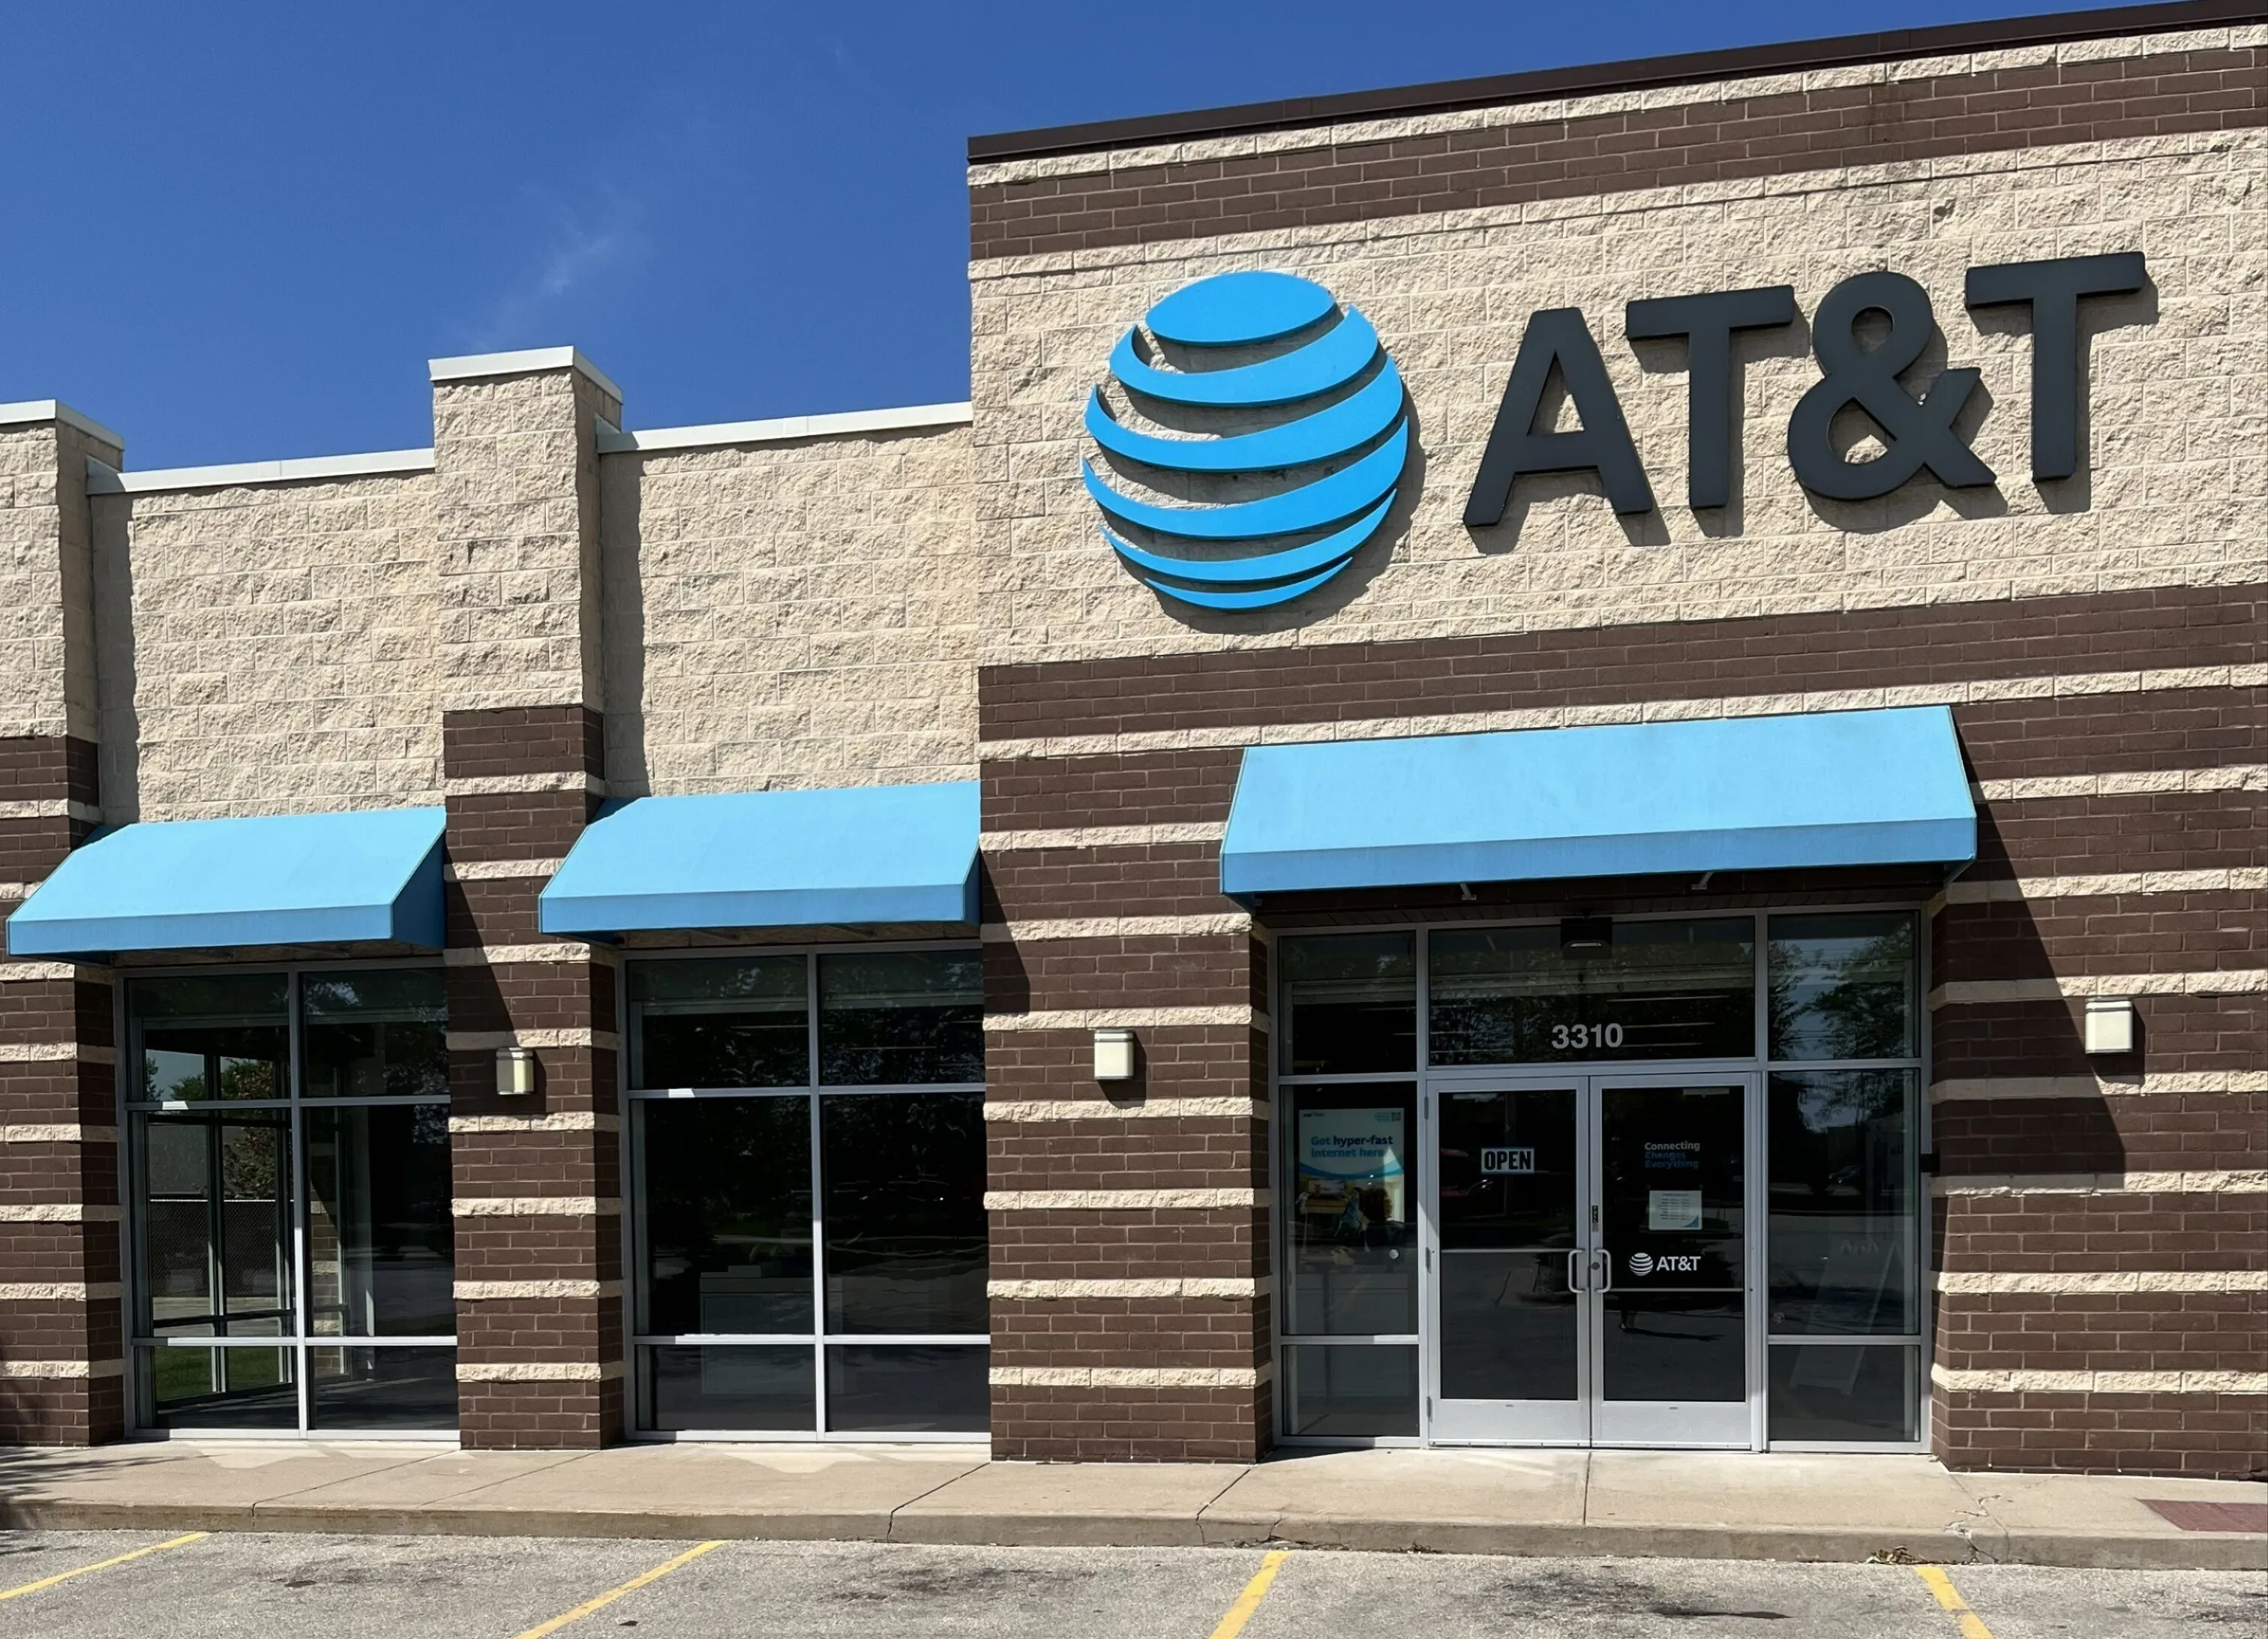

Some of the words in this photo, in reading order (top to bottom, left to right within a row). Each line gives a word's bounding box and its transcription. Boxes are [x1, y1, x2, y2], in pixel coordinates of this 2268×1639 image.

[1463, 251, 2145, 527] AT&T
[1551, 1023, 1623, 1049] 3310
[1311, 1136, 1330, 1145] Get
[1334, 1135, 1394, 1148] hyper-fast
[1644, 1140, 1700, 1151] Connecting
[1484, 1151, 1532, 1170] OPEN
[1645, 1151, 1686, 1160] Changes
[1645, 1160, 1699, 1169] Everything
[1656, 1256, 1701, 1271] AT&T
